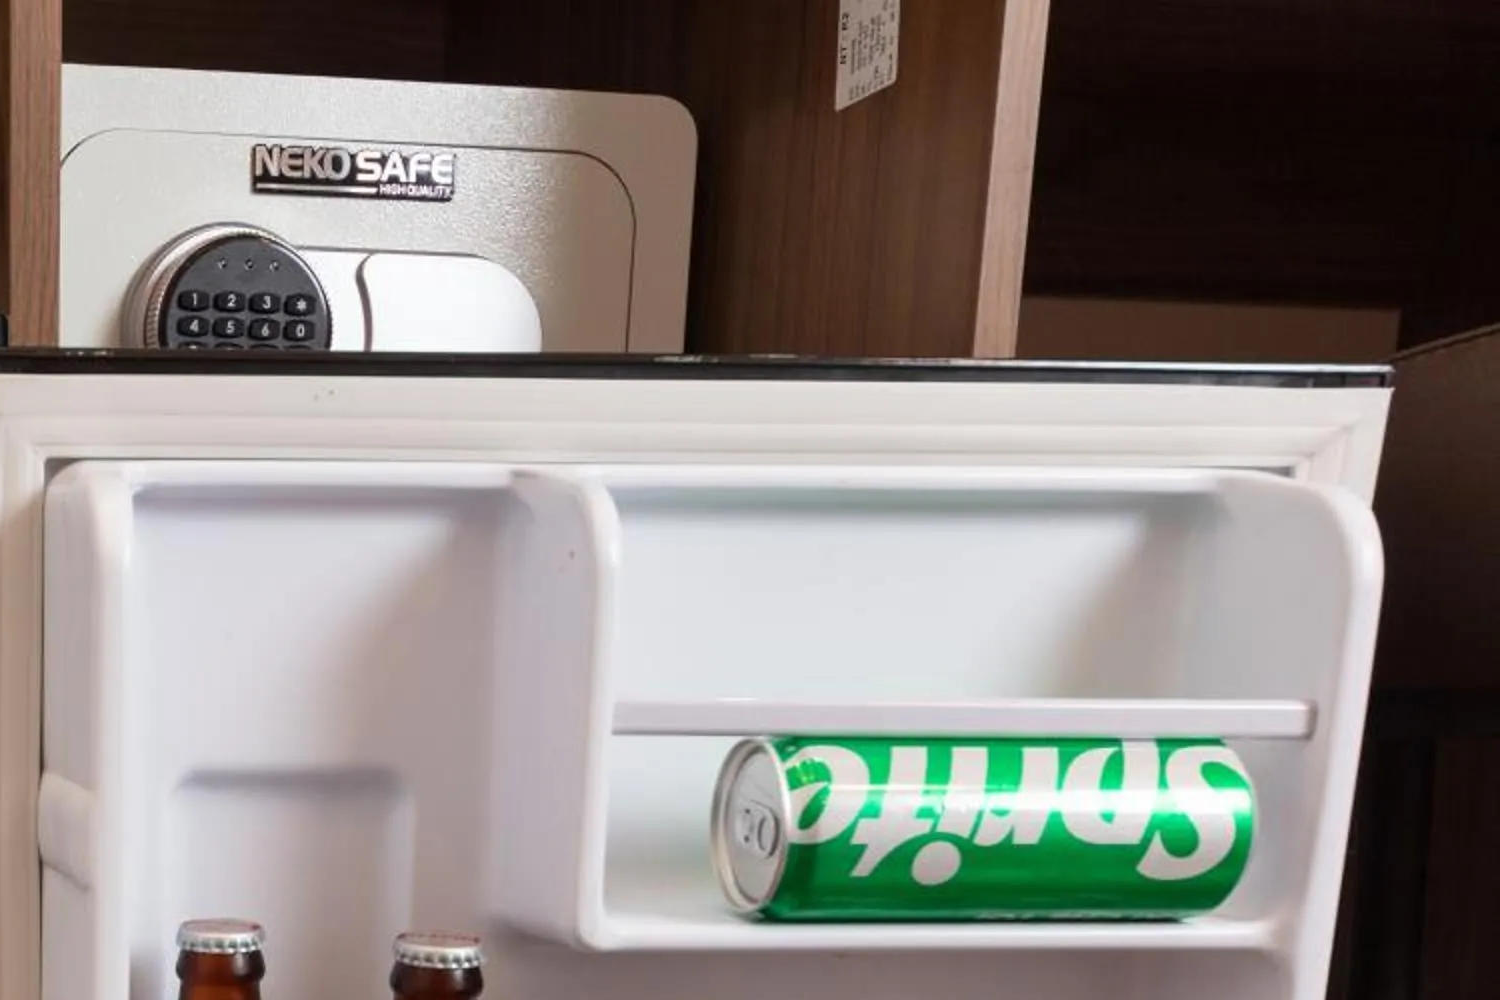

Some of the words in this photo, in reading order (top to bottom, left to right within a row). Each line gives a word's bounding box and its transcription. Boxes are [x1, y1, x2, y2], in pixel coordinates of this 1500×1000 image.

[255, 146, 350, 180] NEKO
[356, 151, 453, 184] SAFE
[227, 296, 237, 307] 2
[262, 296, 271, 309] 3
[189, 321, 199, 333] 4
[226, 321, 235, 334] 5
[261, 324, 270, 336] 6
[786, 736, 1248, 886] Sprite
